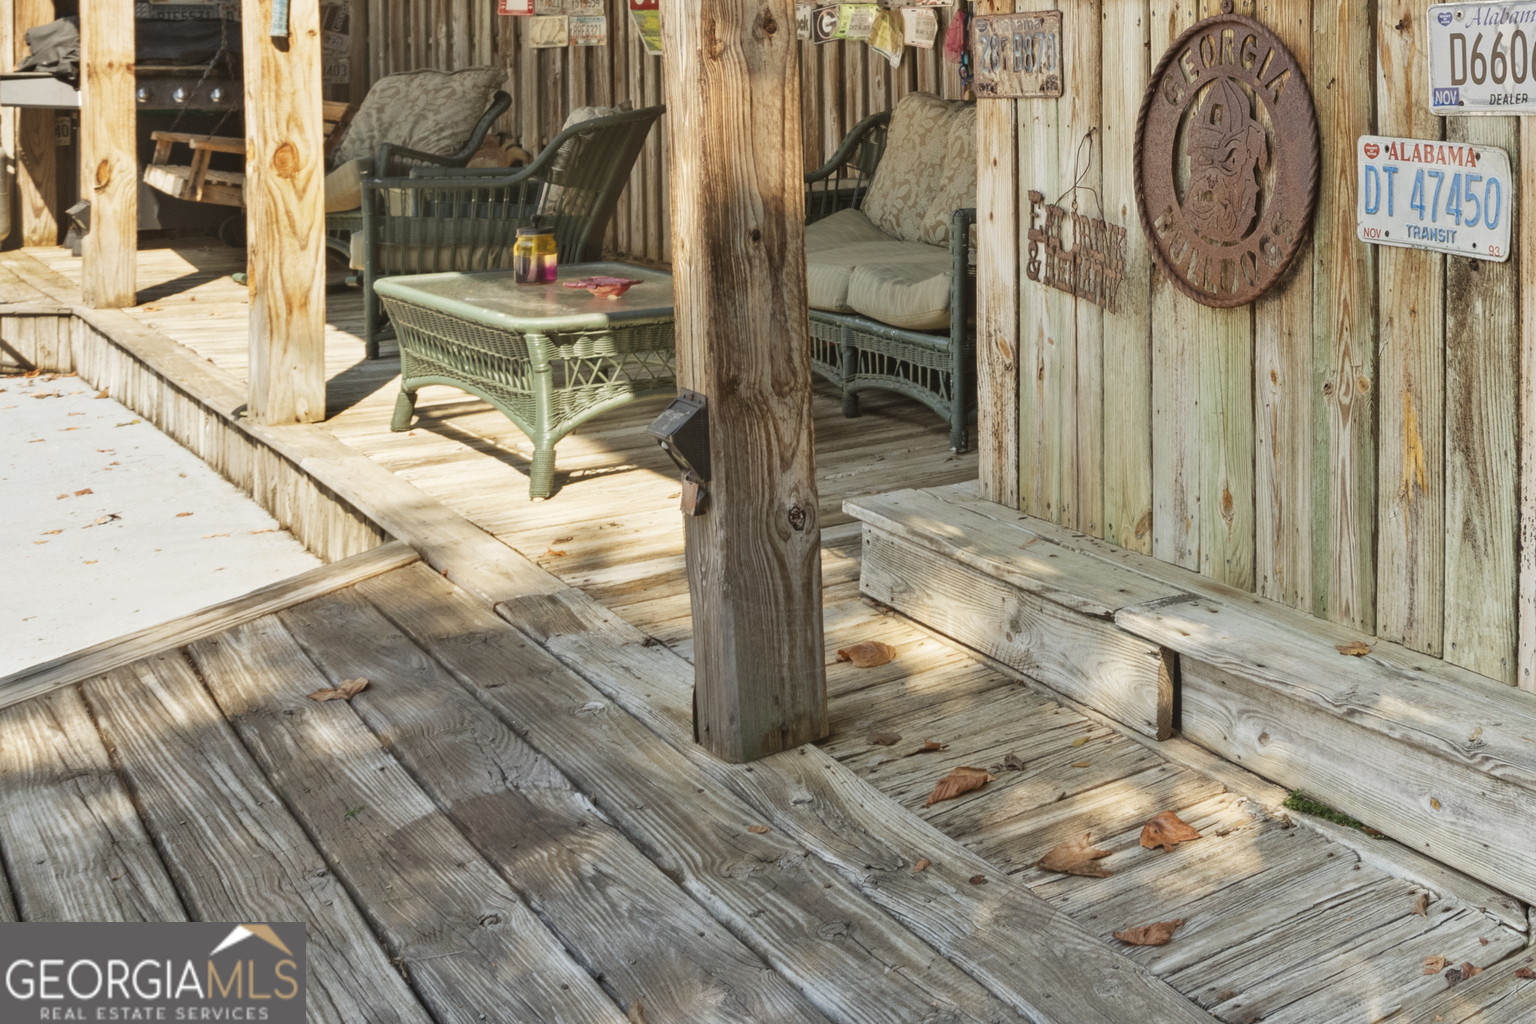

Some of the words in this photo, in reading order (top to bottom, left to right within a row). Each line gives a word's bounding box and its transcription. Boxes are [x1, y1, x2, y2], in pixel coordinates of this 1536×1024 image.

[1163, 28, 1291, 106] GEORGIA
[1435, 89, 1458, 105] NOV
[1489, 93, 1529, 105] DEALER
[1388, 141, 1477, 168] ALABAMA
[1364, 164, 1399, 217] DT
[1410, 167, 1501, 230] 47450
[1363, 227, 1382, 239] NOV
[1405, 224, 1458, 245] TRANSIT
[1154, 205, 1294, 295] BULLDOGS
[1488, 245, 1501, 257] 93
